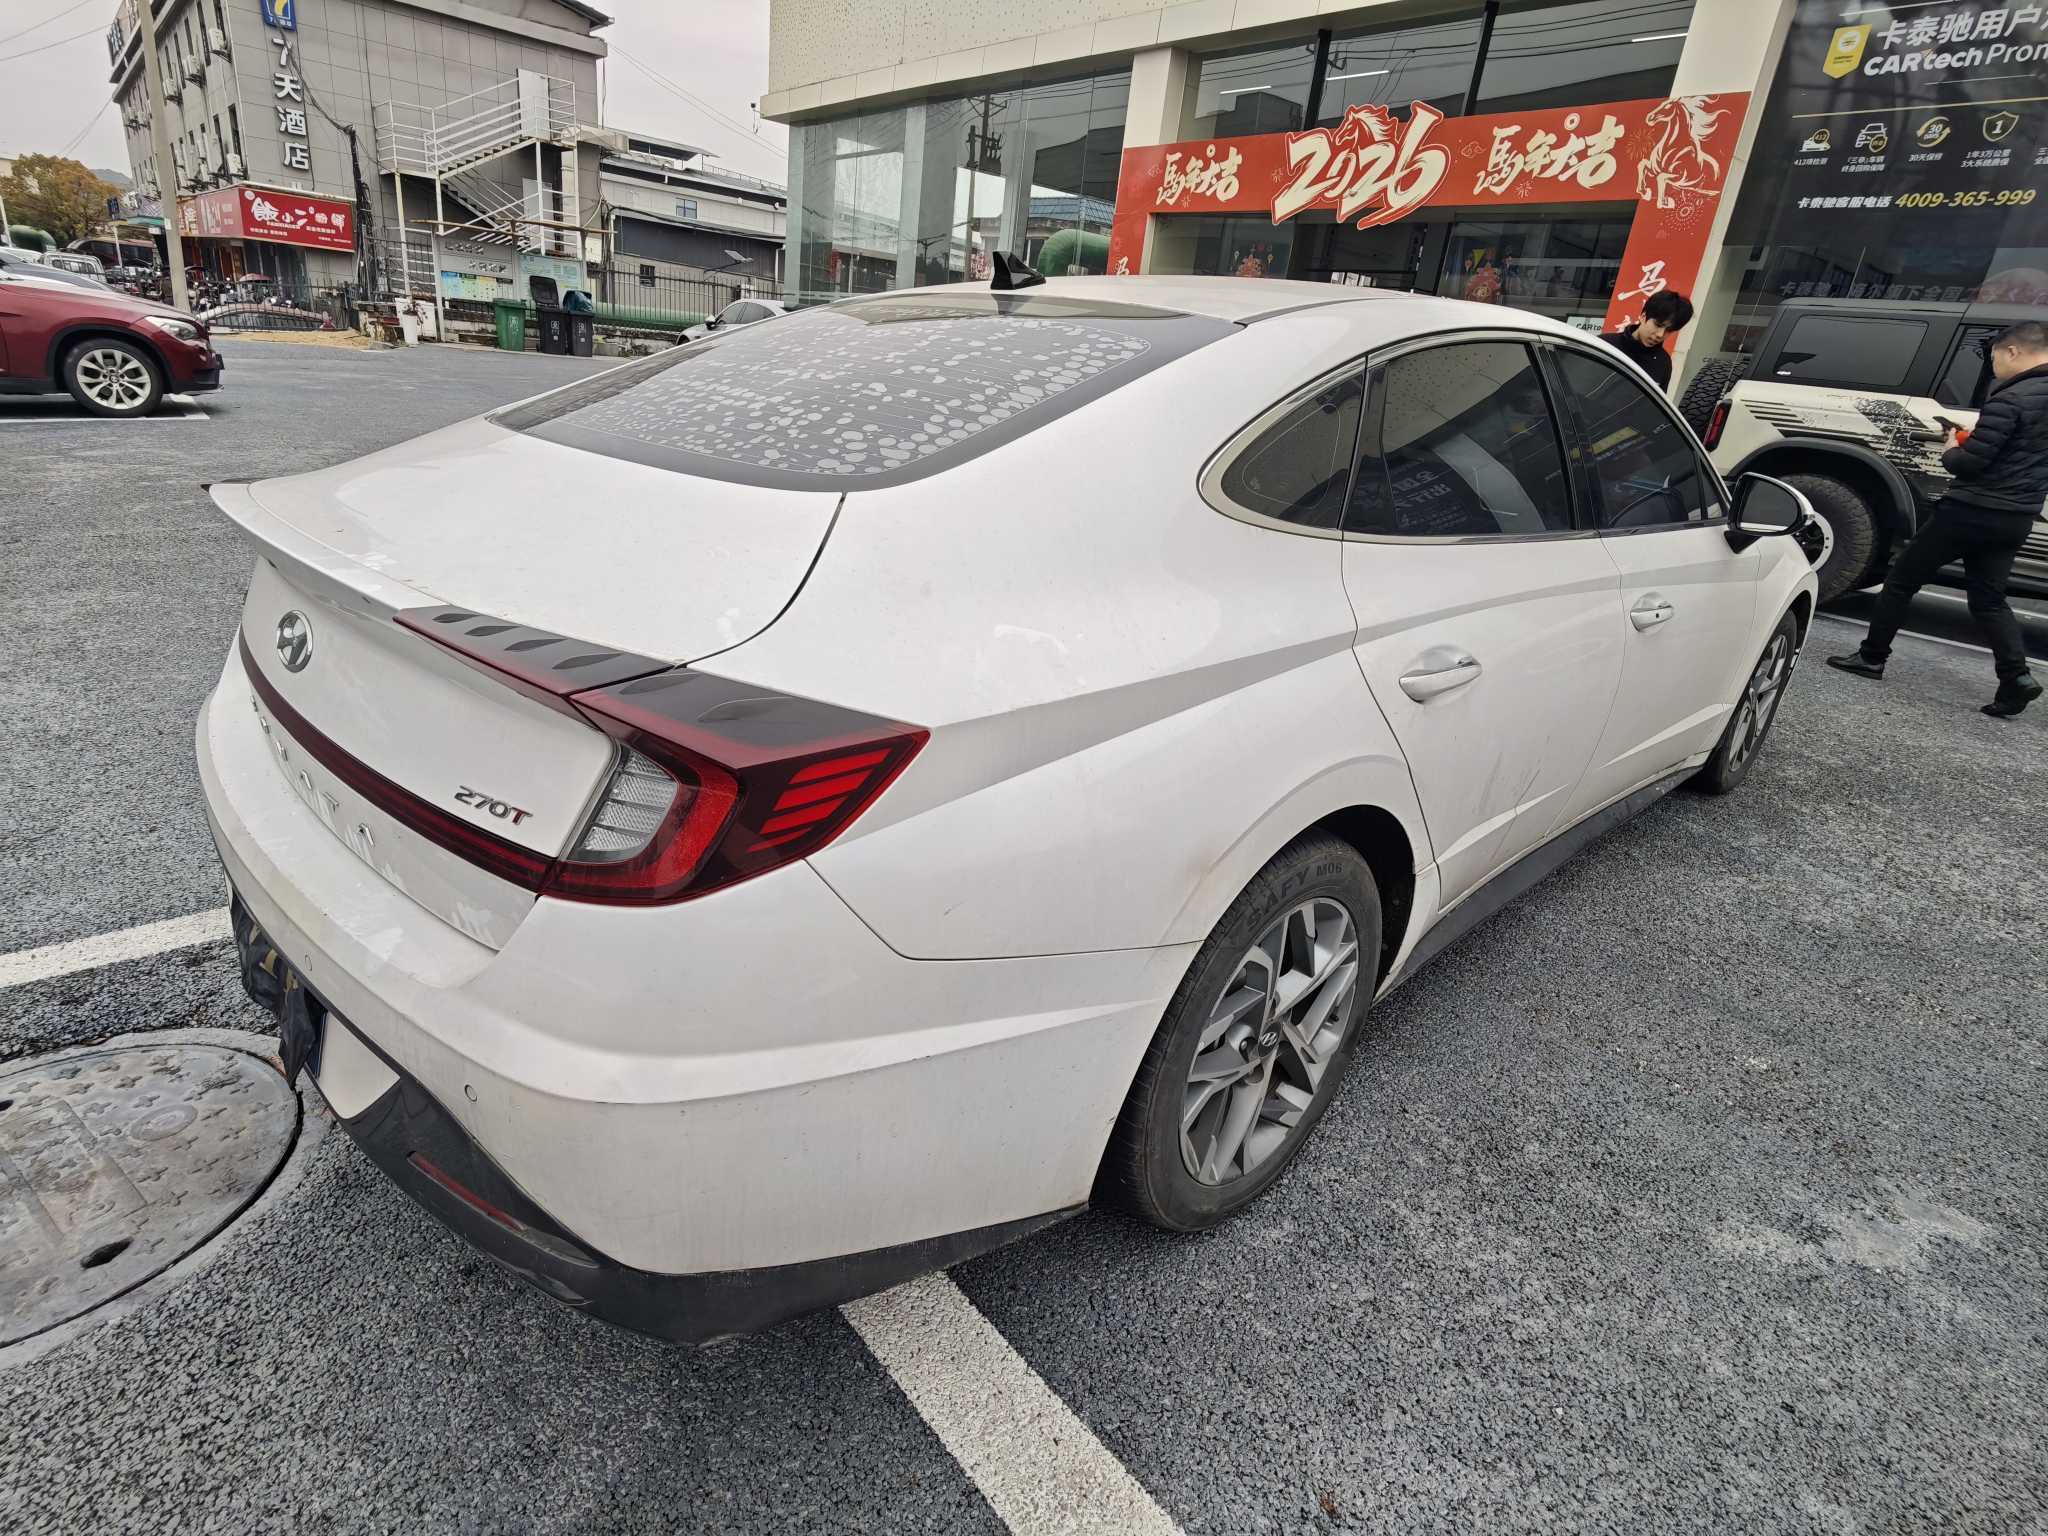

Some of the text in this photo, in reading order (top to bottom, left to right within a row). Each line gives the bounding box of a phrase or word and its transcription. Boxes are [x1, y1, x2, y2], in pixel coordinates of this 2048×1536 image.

[1876, 4, 2048, 50] 卡泰驰用户
[1864, 48, 1983, 76] CARtech
[1272, 103, 1448, 228] 2026
[1894, 188, 2037, 209] 4009-365-999
[454, 784, 534, 826] 270T
